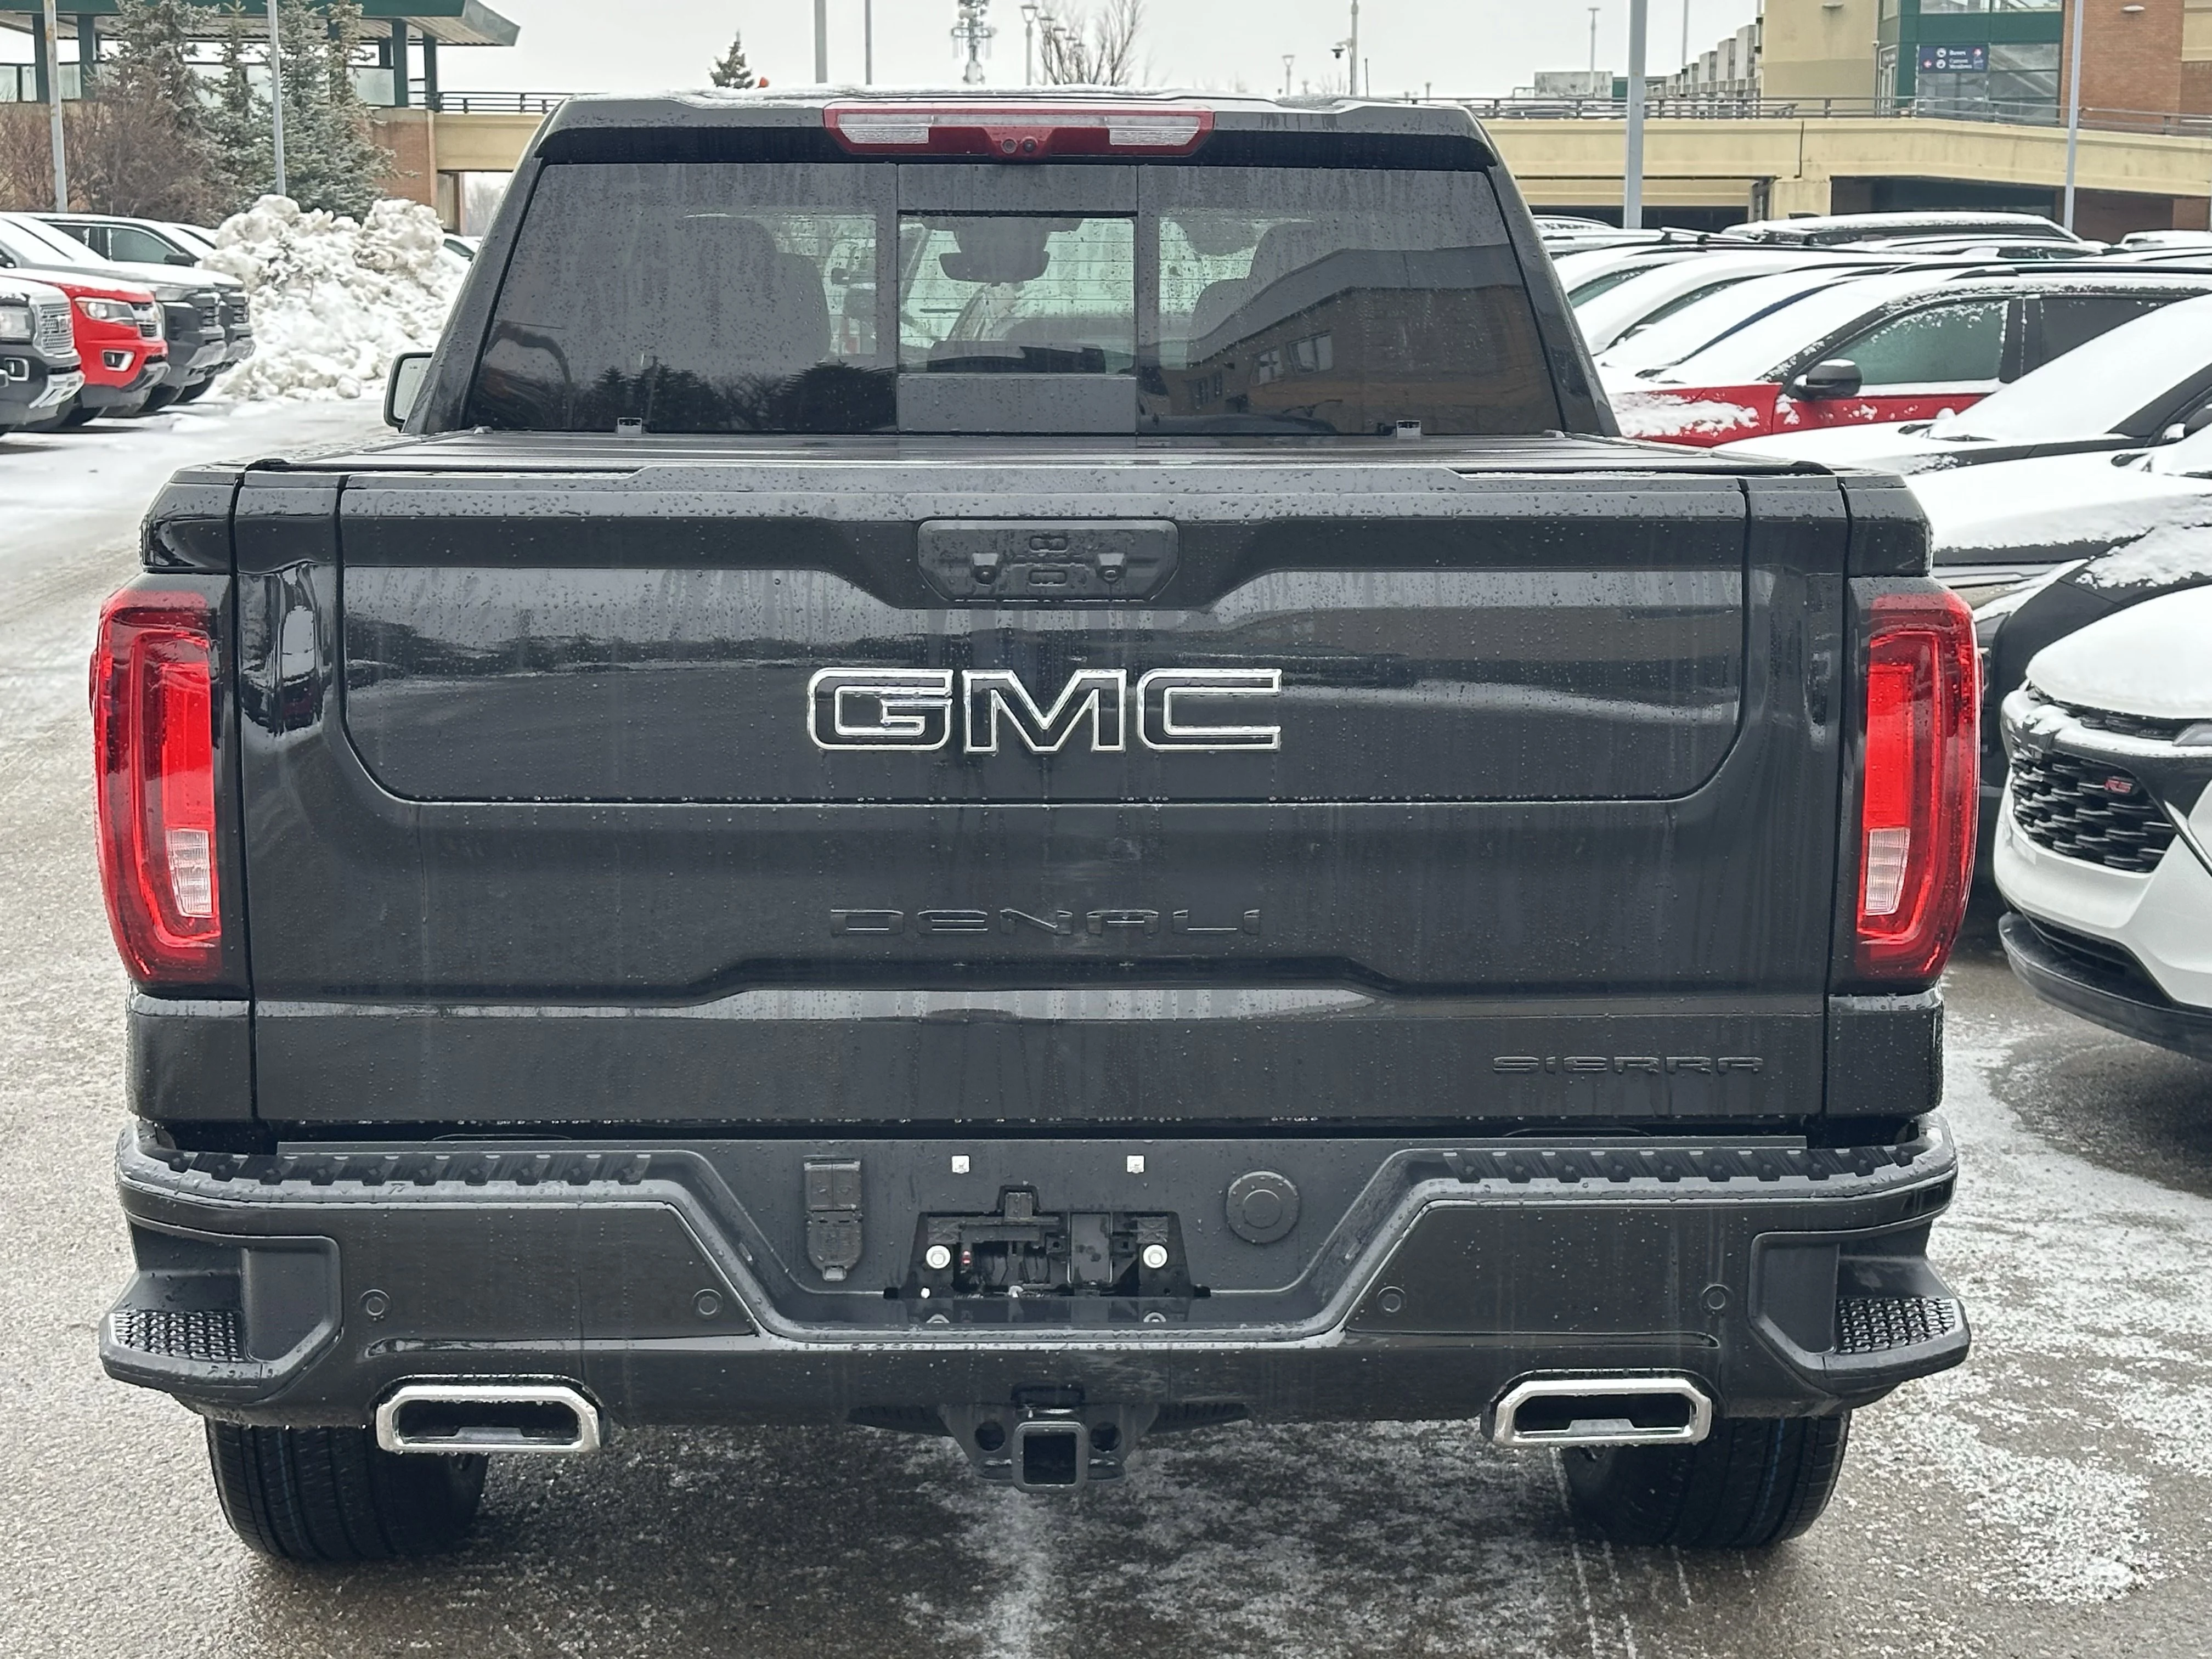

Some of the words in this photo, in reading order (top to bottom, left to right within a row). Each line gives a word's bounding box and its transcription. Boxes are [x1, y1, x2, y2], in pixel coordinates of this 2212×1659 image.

[807, 668, 1283, 753] GMC
[2104, 779, 2133, 793] RS
[830, 909, 1261, 935] DENALI
[1492, 1056, 1763, 1074] SIERRA
